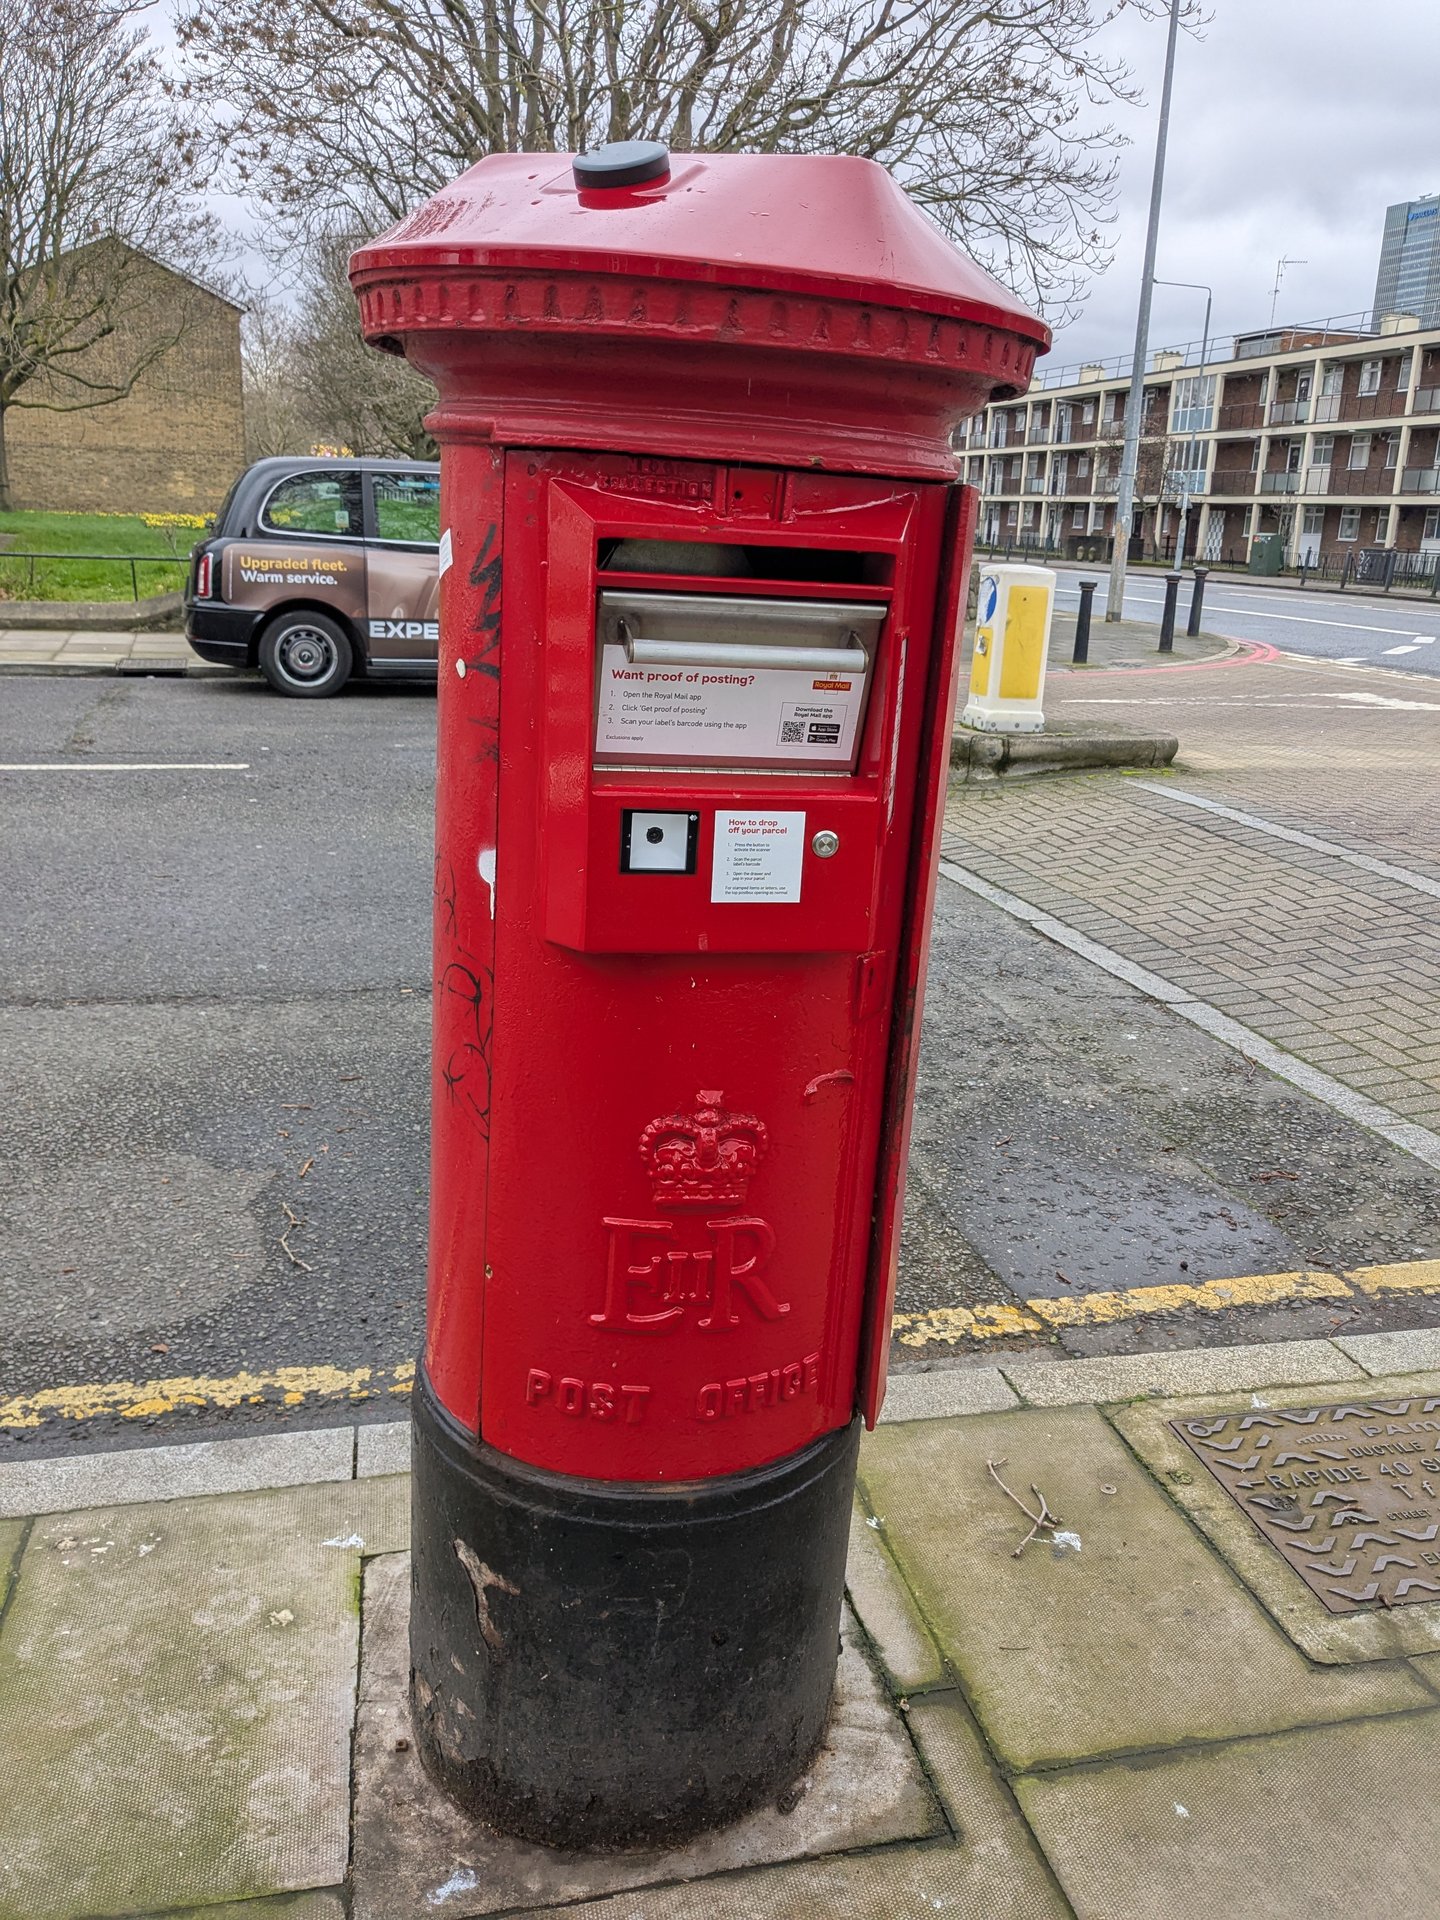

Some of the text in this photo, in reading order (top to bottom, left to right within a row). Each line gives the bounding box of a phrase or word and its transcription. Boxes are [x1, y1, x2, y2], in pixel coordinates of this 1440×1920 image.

[240, 556, 347, 571] Upgraded fleet.
[240, 570, 338, 584] Warm service.
[369, 621, 439, 639] EXPE
[611, 669, 755, 686] Want proof of posting?
[623, 691, 640, 699] Open
[654, 692, 673, 700] Royal
[704, 721, 722, 729] using
[758, 819, 778, 827] drop
[762, 827, 787, 835] parcel
[526, 1351, 819, 1421] POST OFFICE
[1347, 1441, 1425, 1457] DUCTILE
[1264, 1457, 1440, 1489] RAPIDE 40 S
[1386, 1508, 1432, 1521] STREET
